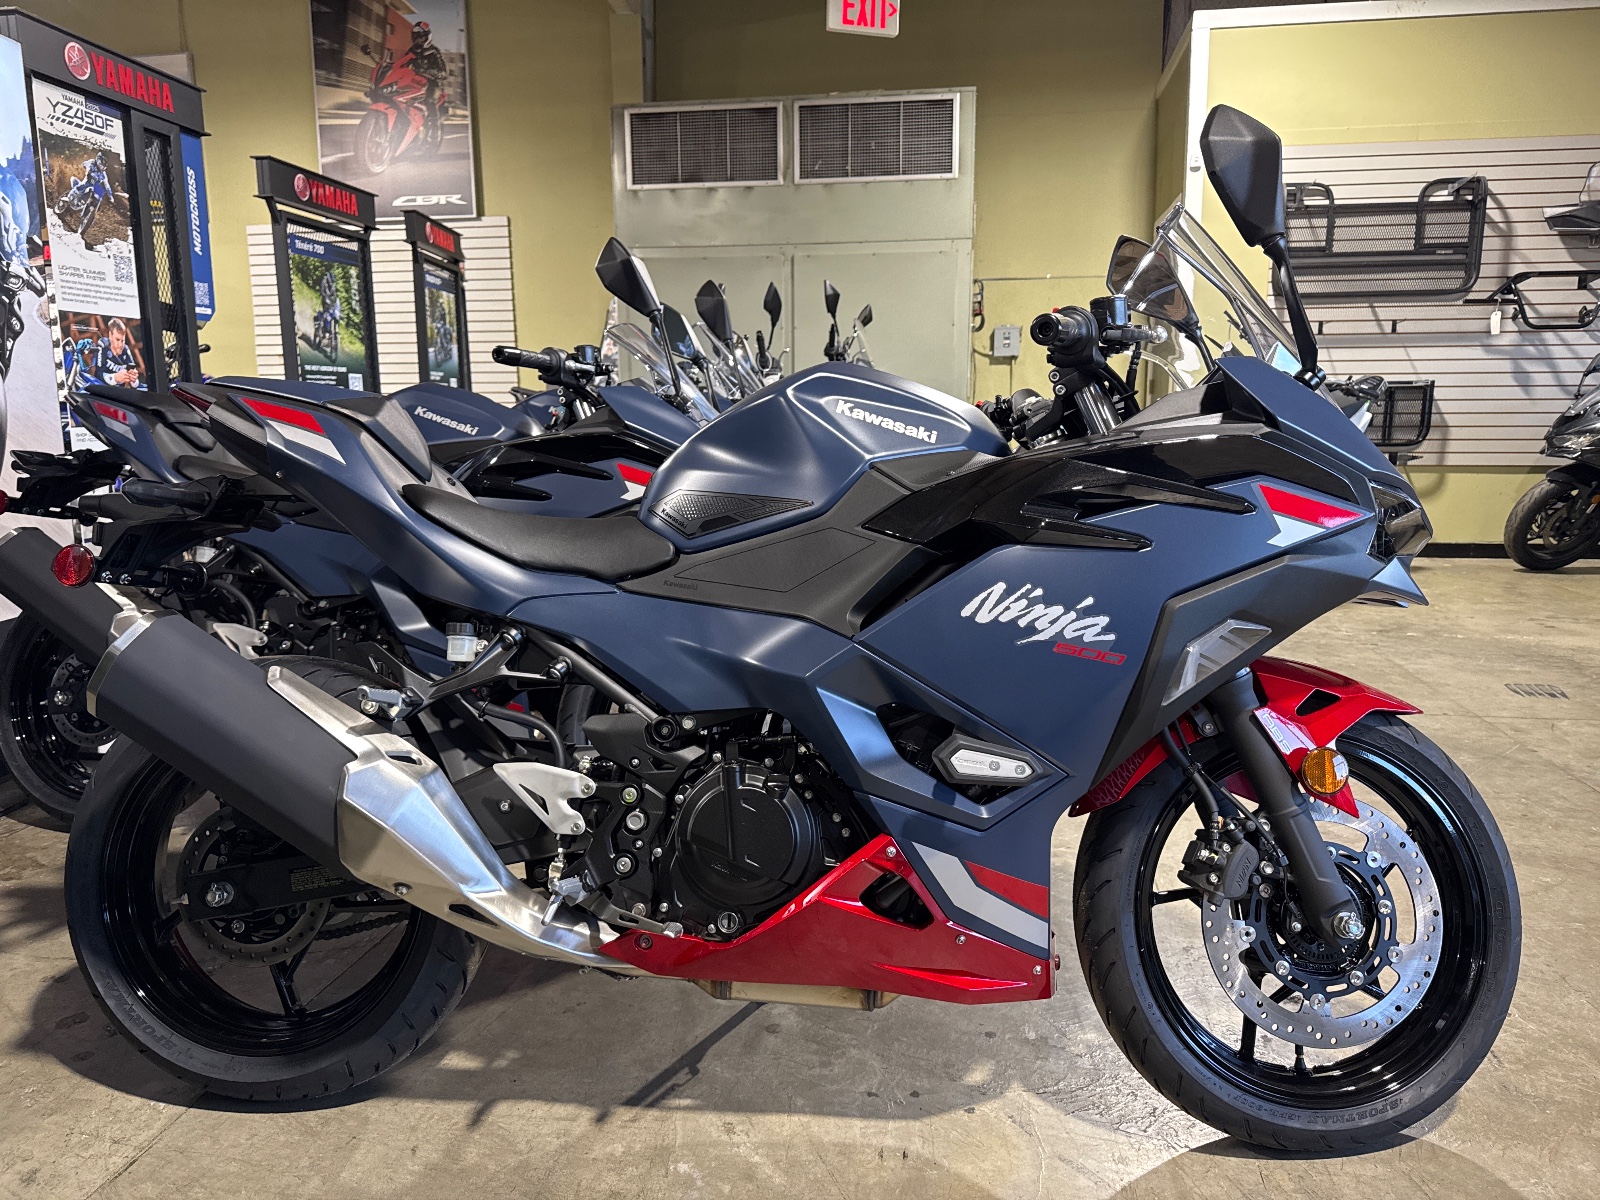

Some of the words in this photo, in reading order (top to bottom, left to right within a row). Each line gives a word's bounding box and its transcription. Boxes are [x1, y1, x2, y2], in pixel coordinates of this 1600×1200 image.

[841, 0, 886, 28] EXIT
[89, 51, 175, 114] YAMAHA
[46, 96, 114, 131] YZ450F
[61, 93, 85, 107] YAMAHA
[86, 102, 100, 113] 2025
[186, 166, 203, 256] MOTOCROSS
[309, 178, 359, 217] YAMAHA
[391, 194, 468, 207] CBR
[414, 405, 480, 436] Kawasaki
[836, 399, 938, 444] Kawasaki
[660, 509, 689, 530] Kawasaki
[663, 579, 698, 591] Kawasaki
[960, 581, 1117, 645] Ninja
[1053, 641, 1128, 666] 500
[1262, 713, 1291, 755] ABS
[1306, 1097, 1400, 1125] SPORTMAX
